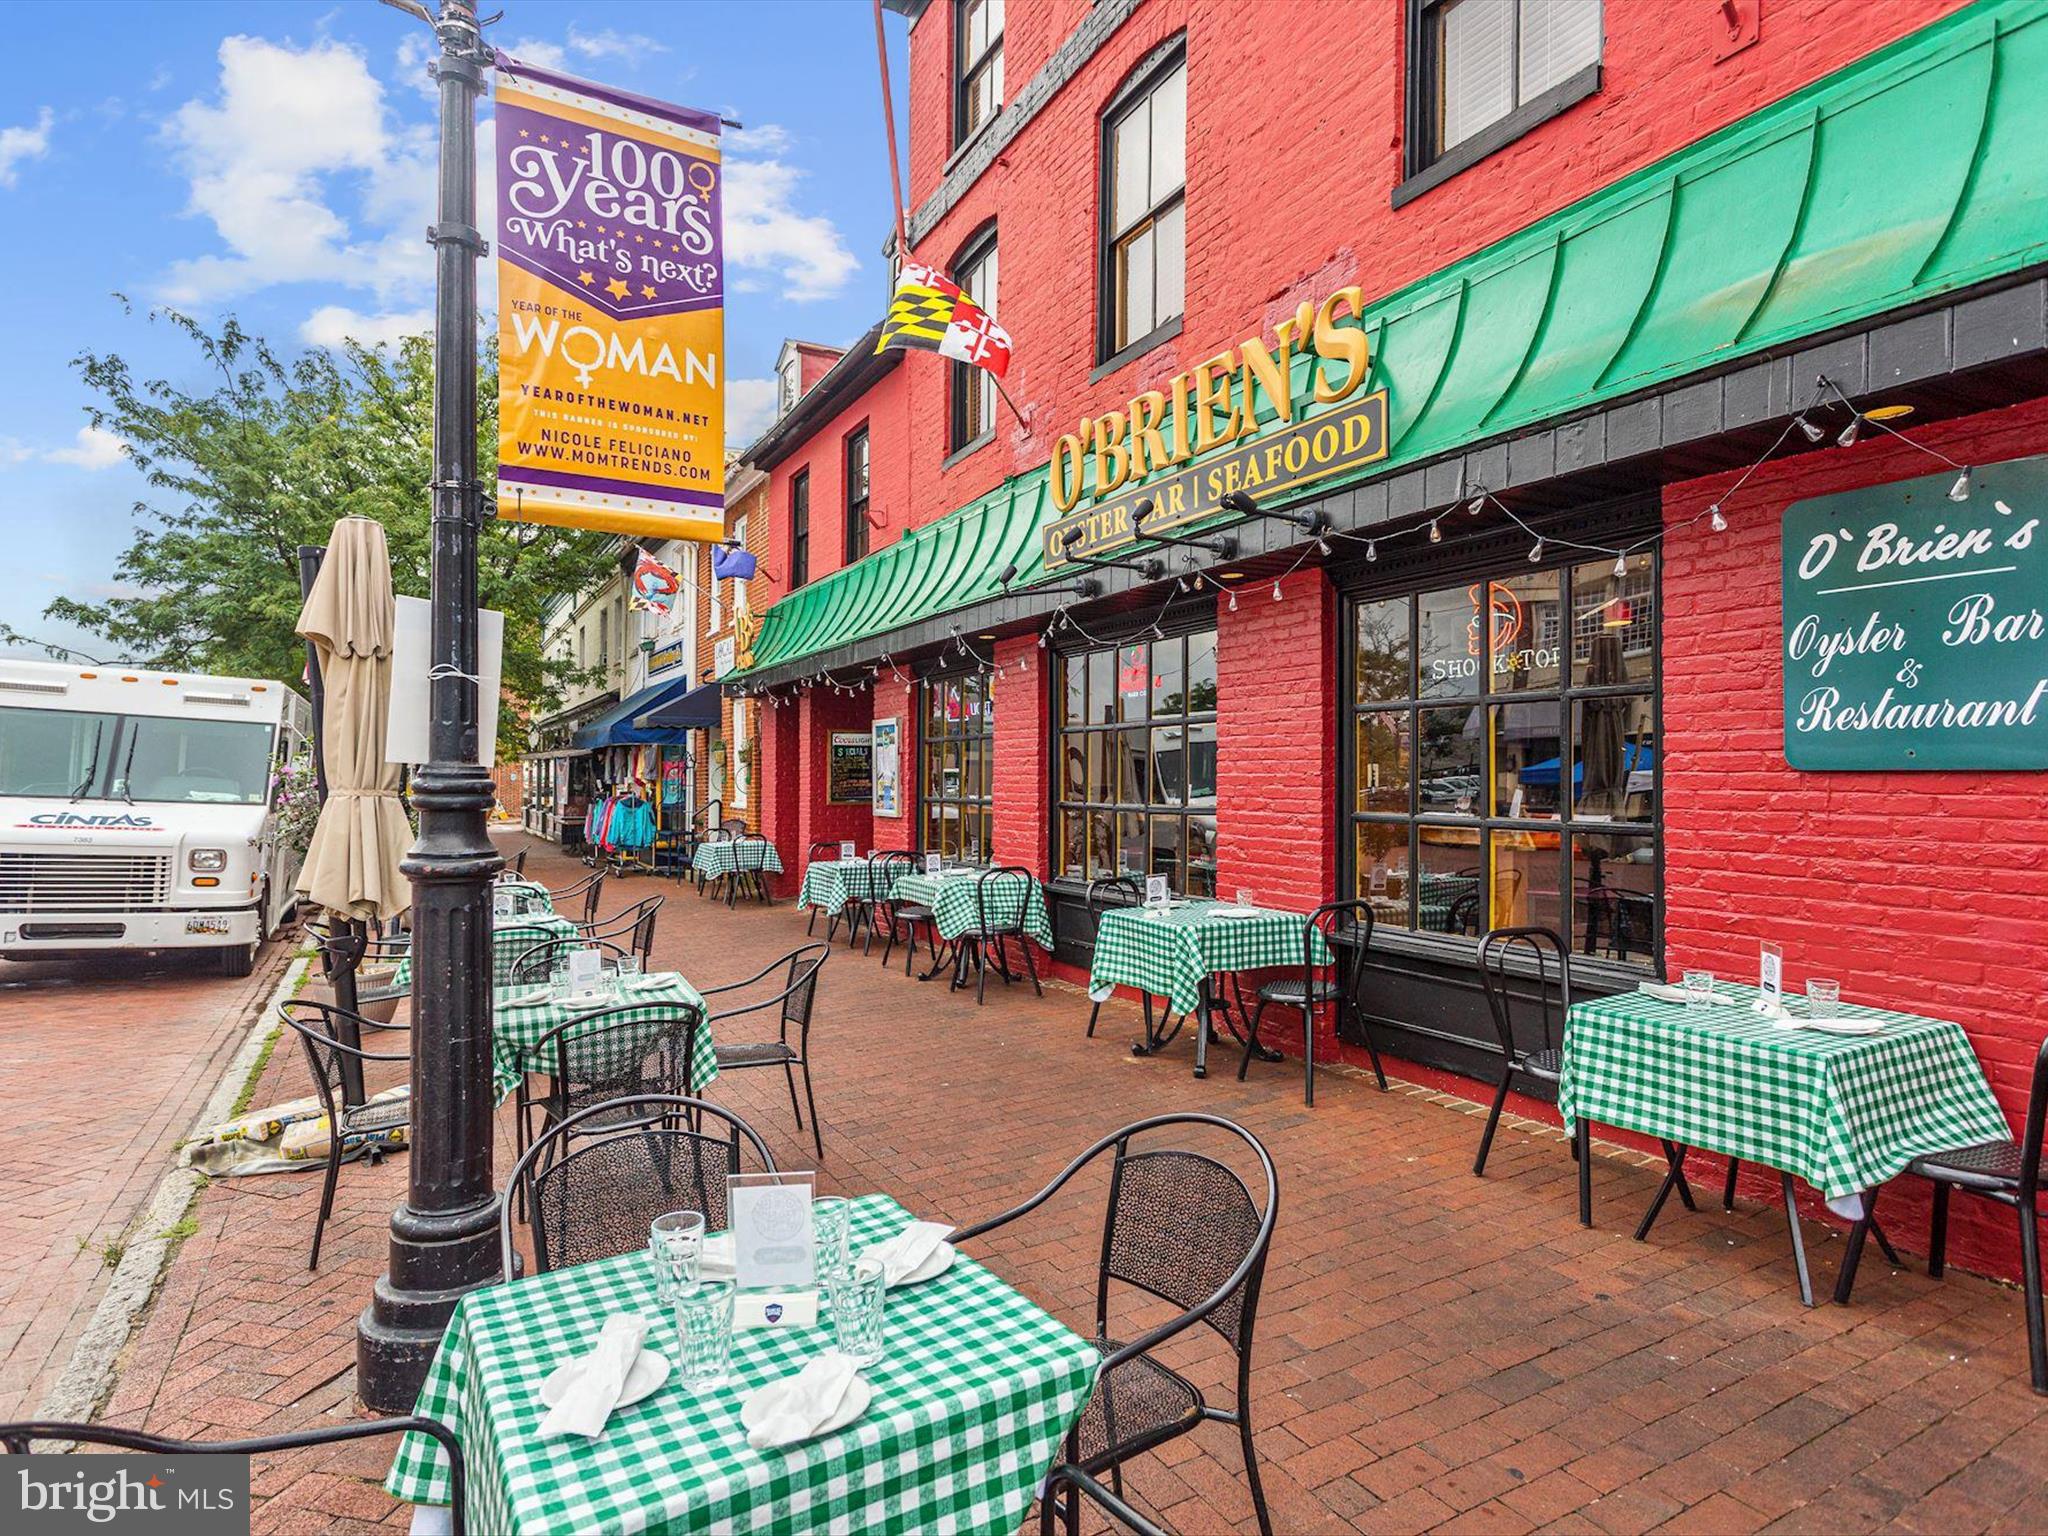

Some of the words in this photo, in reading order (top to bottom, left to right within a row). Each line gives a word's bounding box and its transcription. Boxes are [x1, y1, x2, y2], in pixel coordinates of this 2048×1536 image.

[585, 132, 685, 199] 100
[508, 145, 714, 255] Years
[506, 216, 632, 273] What's
[640, 255, 718, 294] next?
[511, 299, 542, 313] YEAR
[544, 306, 558, 316] OF
[561, 308, 583, 322] THE
[511, 312, 716, 390] WOMAN
[520, 384, 710, 427] YEAROFTHEWOMAN.NET
[1049, 286, 1370, 513] O'BRIEN'S
[517, 442, 711, 481] WWW.MOMTRENDS.COM
[541, 429, 601, 449] NICOLE
[609, 439, 692, 463] FELICIANO
[1207, 414, 1371, 502] SEAFOOD
[1788, 611, 1906, 678] Oyster
[1942, 593, 2045, 647] Bar
[1796, 679, 2048, 732] Restaurant
[1896, 658, 1923, 688] &
